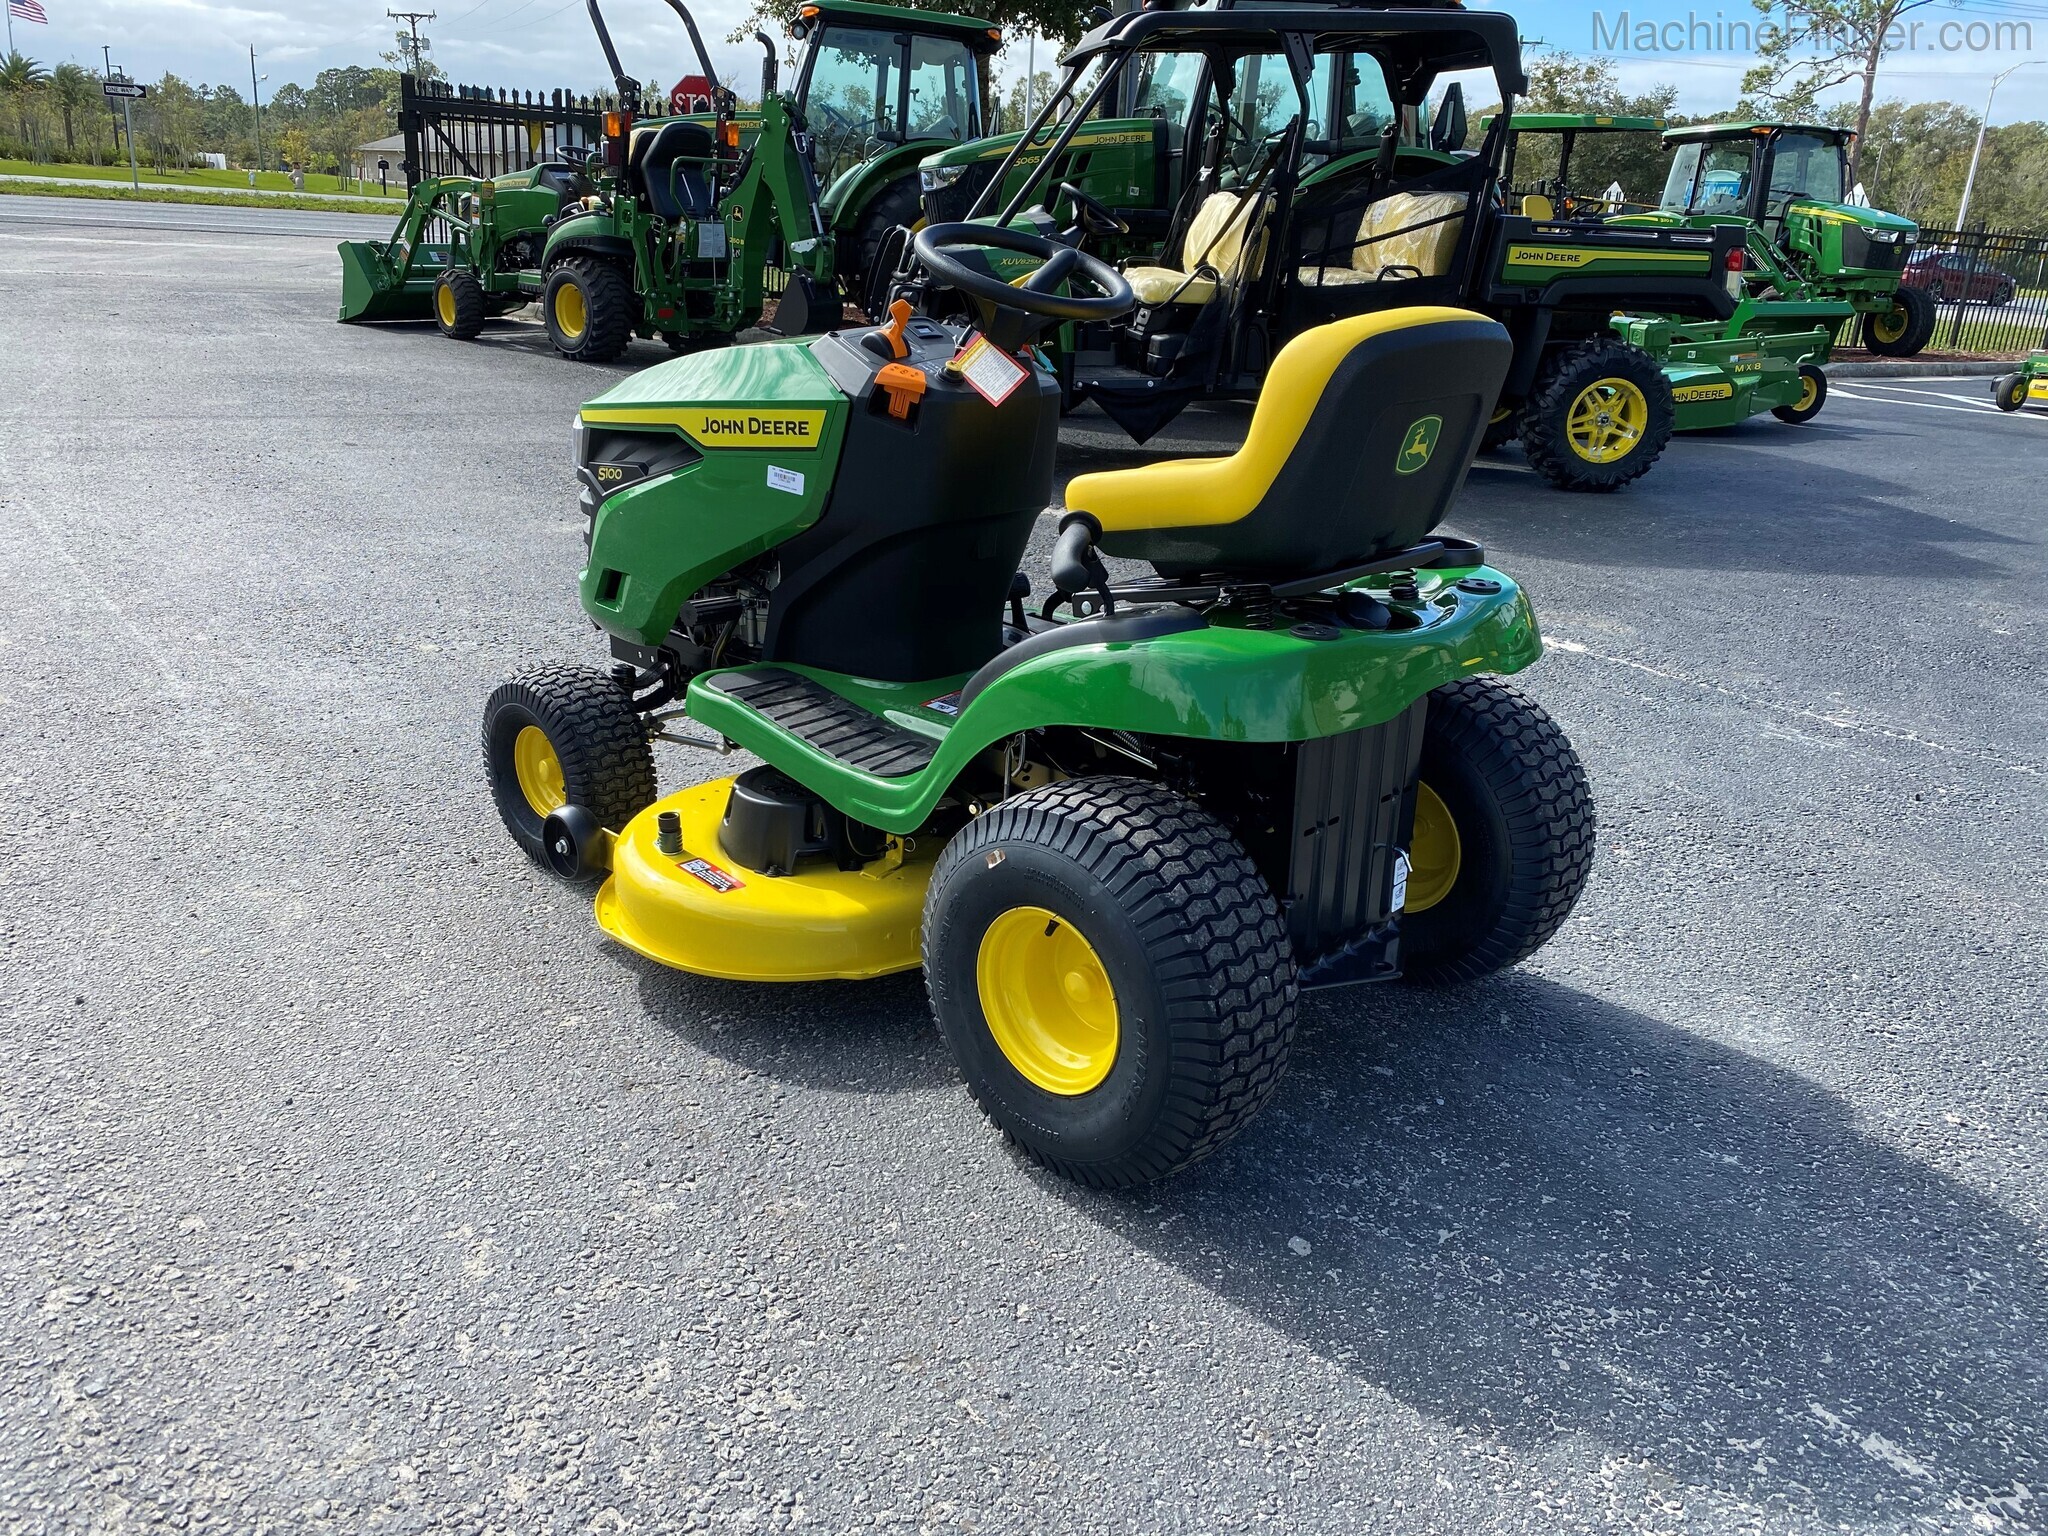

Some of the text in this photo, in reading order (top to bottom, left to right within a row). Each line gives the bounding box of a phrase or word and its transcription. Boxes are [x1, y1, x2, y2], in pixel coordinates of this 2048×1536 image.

[1094, 134, 1146, 144] JOHN DEERE
[1515, 251, 1581, 262] JOHN DEERE
[1673, 389, 1725, 401] HN DEERE
[701, 416, 809, 436] JOHN DEERE
[598, 467, 623, 481] S100
